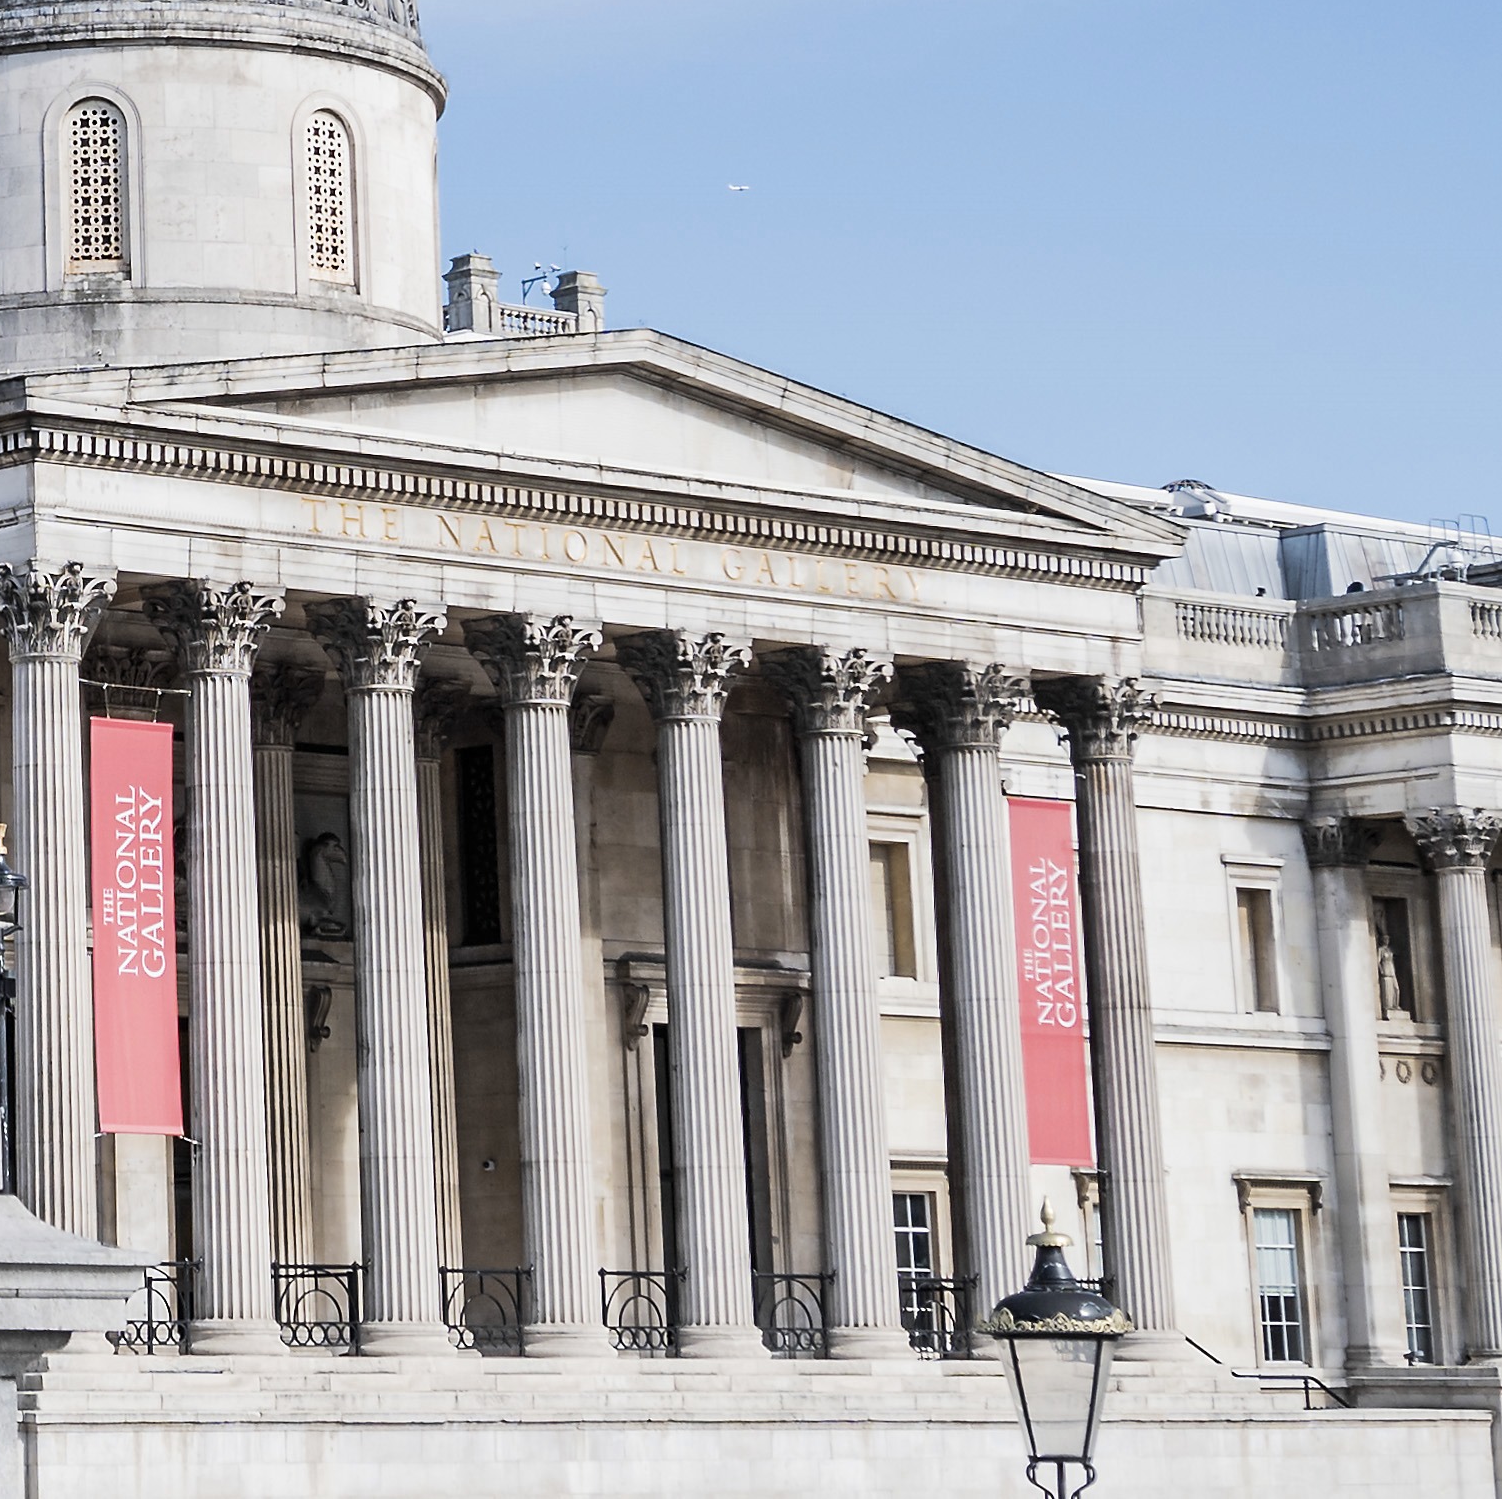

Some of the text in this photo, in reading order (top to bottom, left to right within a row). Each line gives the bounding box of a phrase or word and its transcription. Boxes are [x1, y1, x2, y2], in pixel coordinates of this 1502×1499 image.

[301, 497, 924, 602] THE NATIONAL GALLERY
[103, 888, 114, 926] THE
[116, 784, 139, 977] NATIONAL
[139, 786, 166, 978] GALLERY
[1023, 948, 1036, 982] THE
[1029, 857, 1055, 1027] NATIONAL
[1047, 858, 1077, 1028] GALLERY
